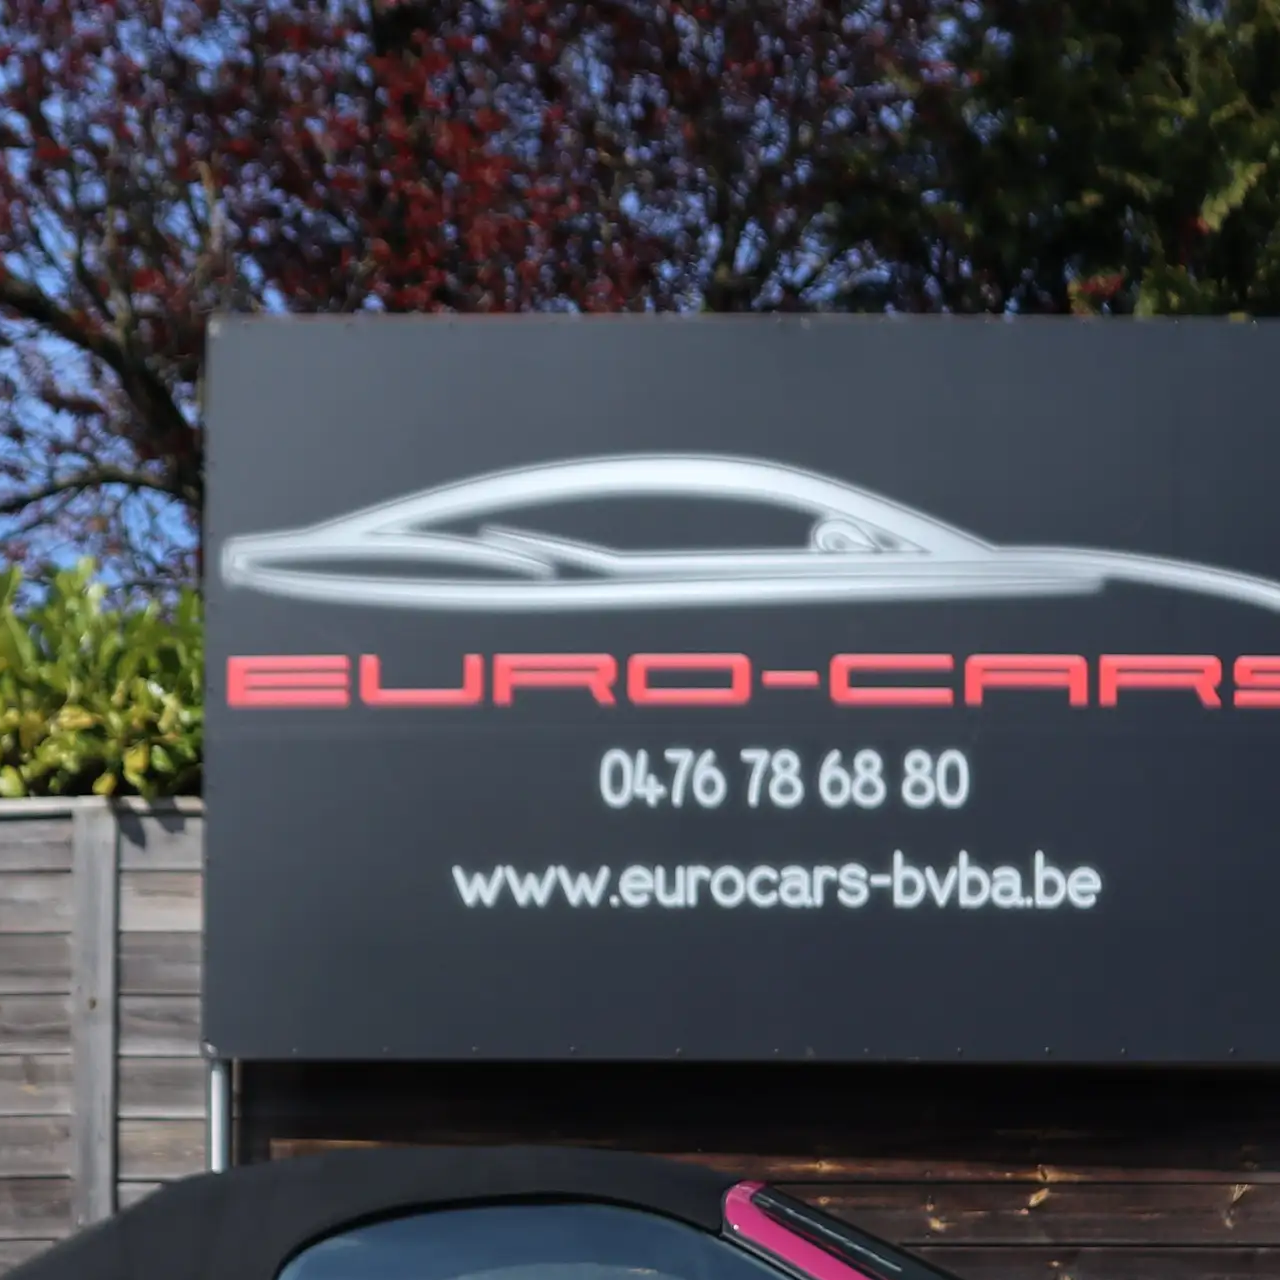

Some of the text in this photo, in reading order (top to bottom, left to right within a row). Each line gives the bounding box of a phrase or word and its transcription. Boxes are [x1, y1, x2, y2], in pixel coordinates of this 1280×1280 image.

[599, 748, 970, 809] 0476 78 68 80
[451, 849, 1102, 909] www.eurocars-bvba.be
